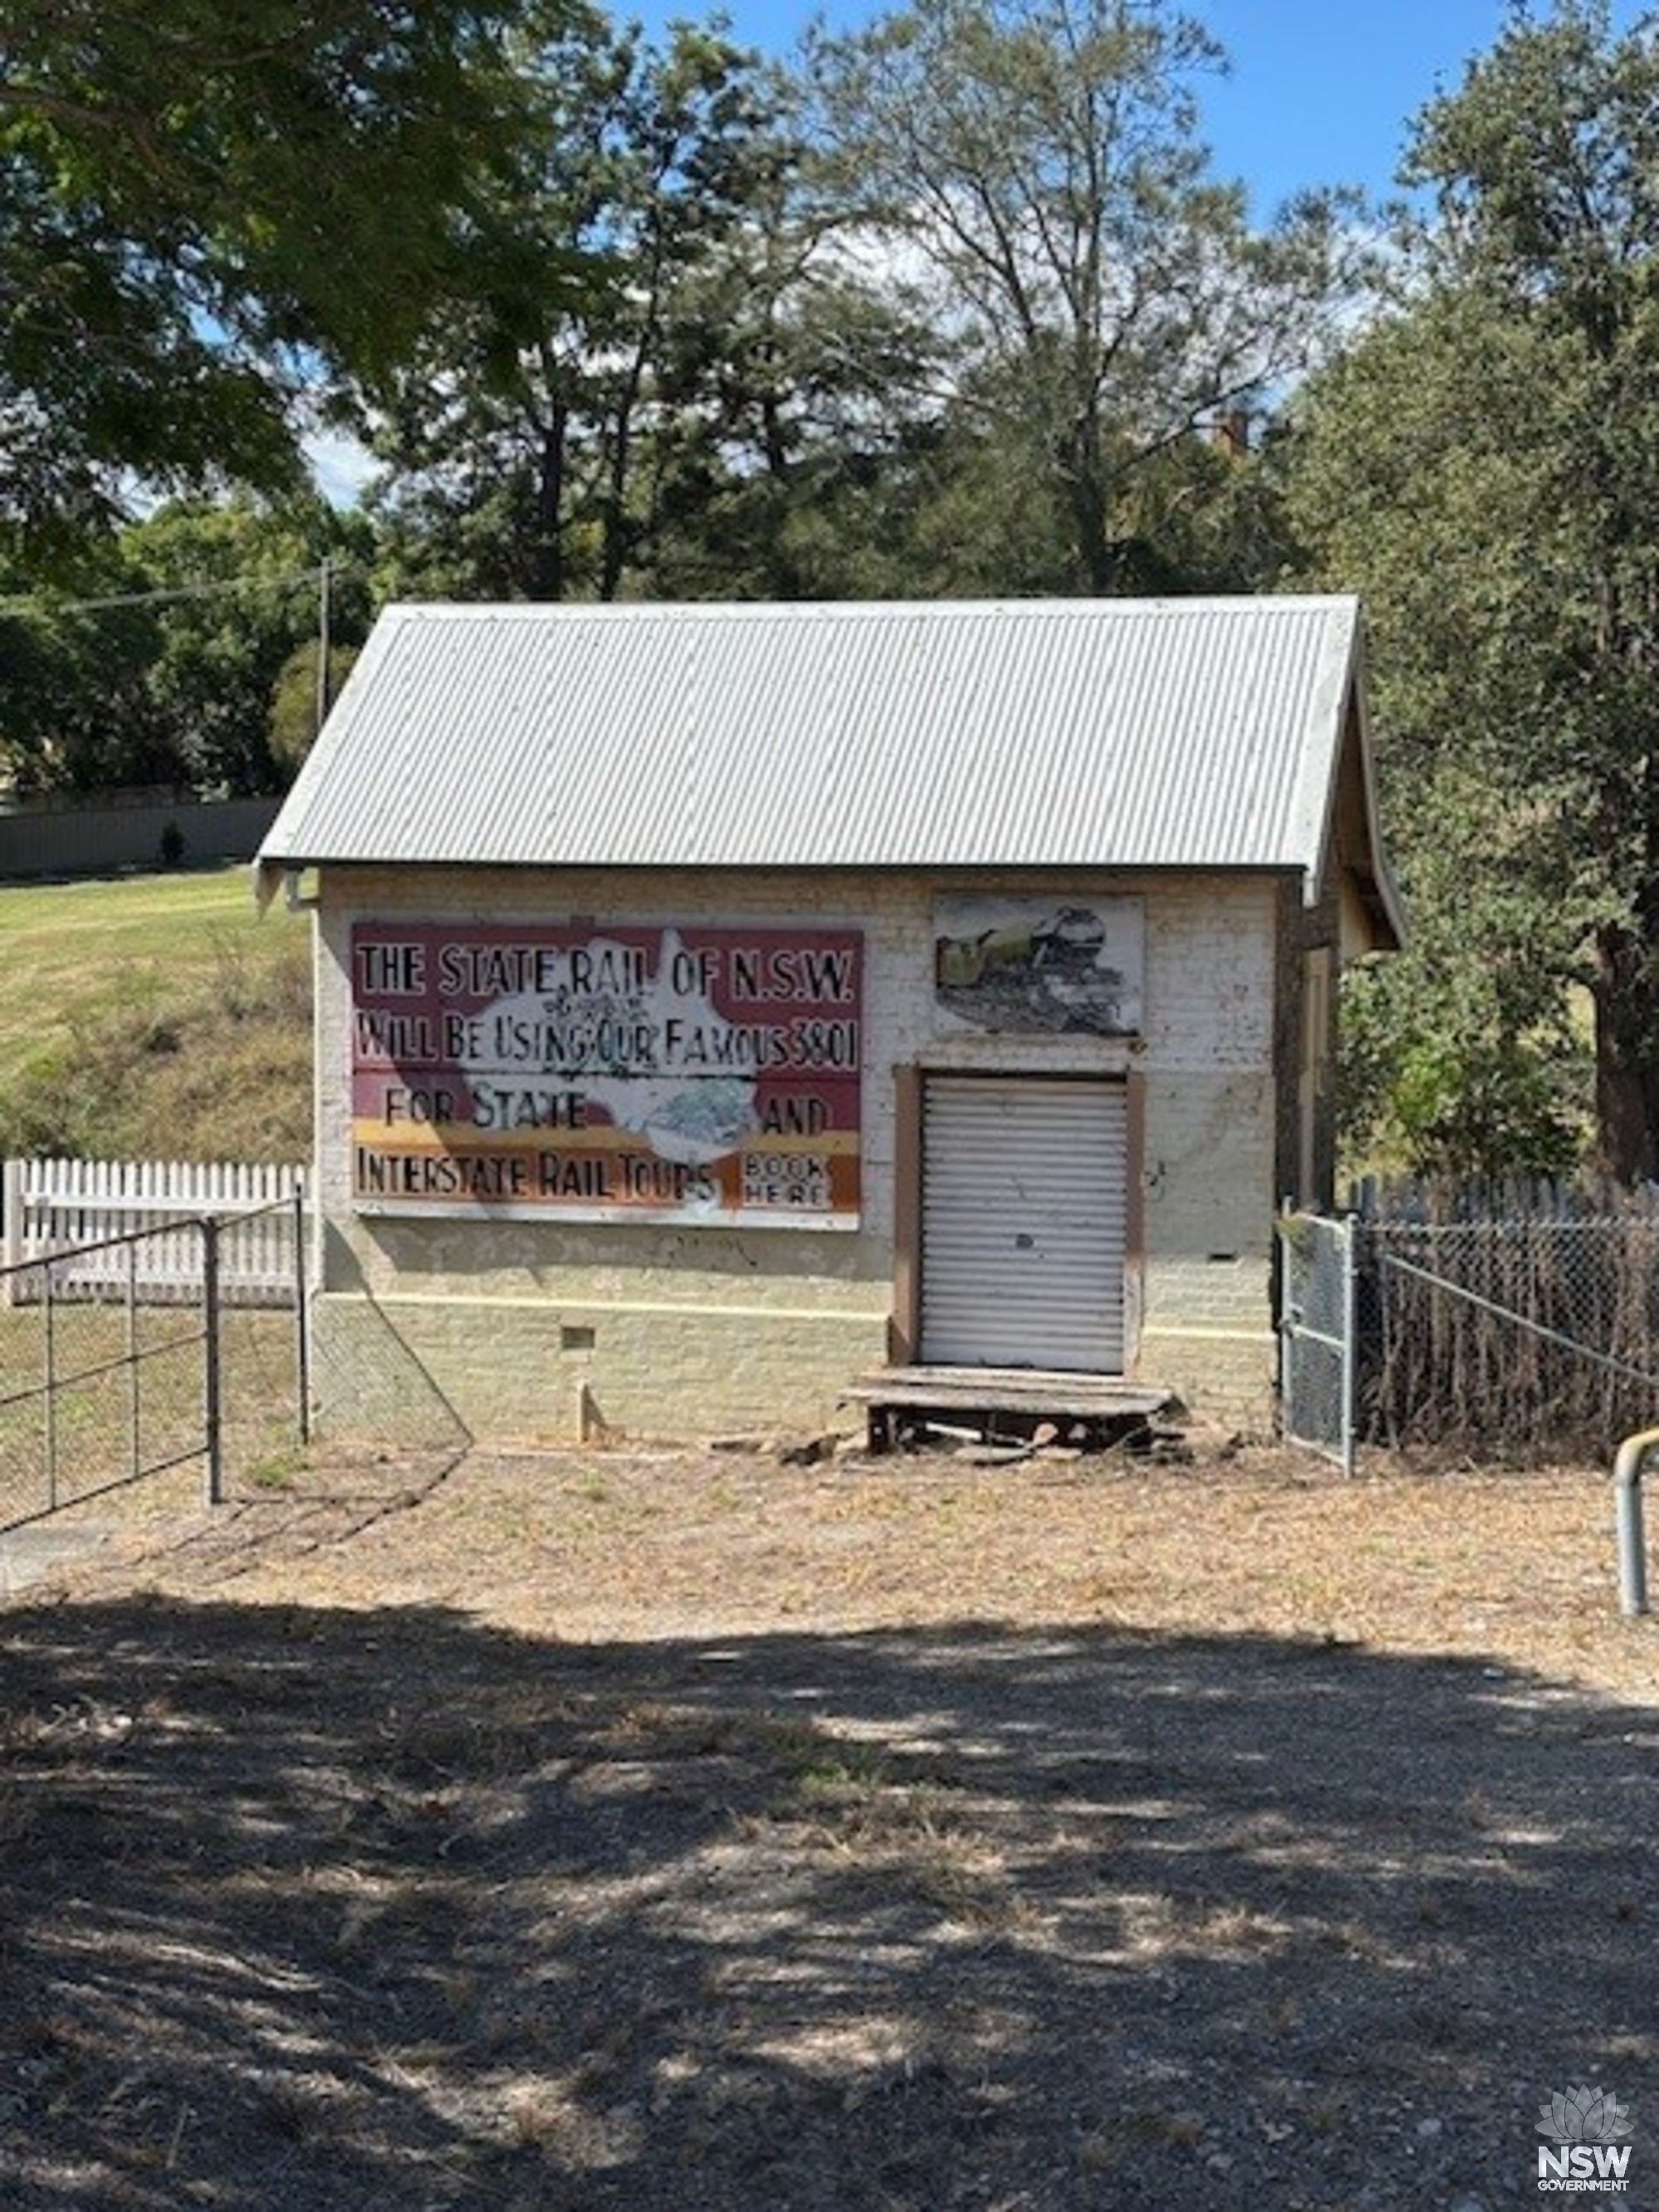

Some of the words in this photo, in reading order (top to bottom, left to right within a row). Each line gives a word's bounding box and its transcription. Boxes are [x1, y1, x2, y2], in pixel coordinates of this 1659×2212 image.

[357, 946, 425, 992] THE
[440, 948, 554, 994] STATE
[569, 950, 649, 995] RAIL
[671, 950, 720, 997] OF
[733, 951, 854, 1000] N.S.W.
[357, 1011, 436, 1060] WILL
[445, 1014, 484, 1060] BE
[497, 1016, 586, 1062] USING
[597, 1019, 652, 1063] OUR
[665, 1019, 789, 1065] FAMOUS
[791, 1019, 857, 1069] 3801
[386, 1088, 454, 1127] FOR
[472, 1082, 586, 1130] STATE
[762, 1096, 828, 1136] AND
[358, 1146, 527, 1195] INTERSTATE
[540, 1152, 612, 1198] RAIL
[619, 1155, 715, 1202] TOURS
[746, 1155, 827, 1179] BOOK
[746, 1184, 826, 1205] HERE
